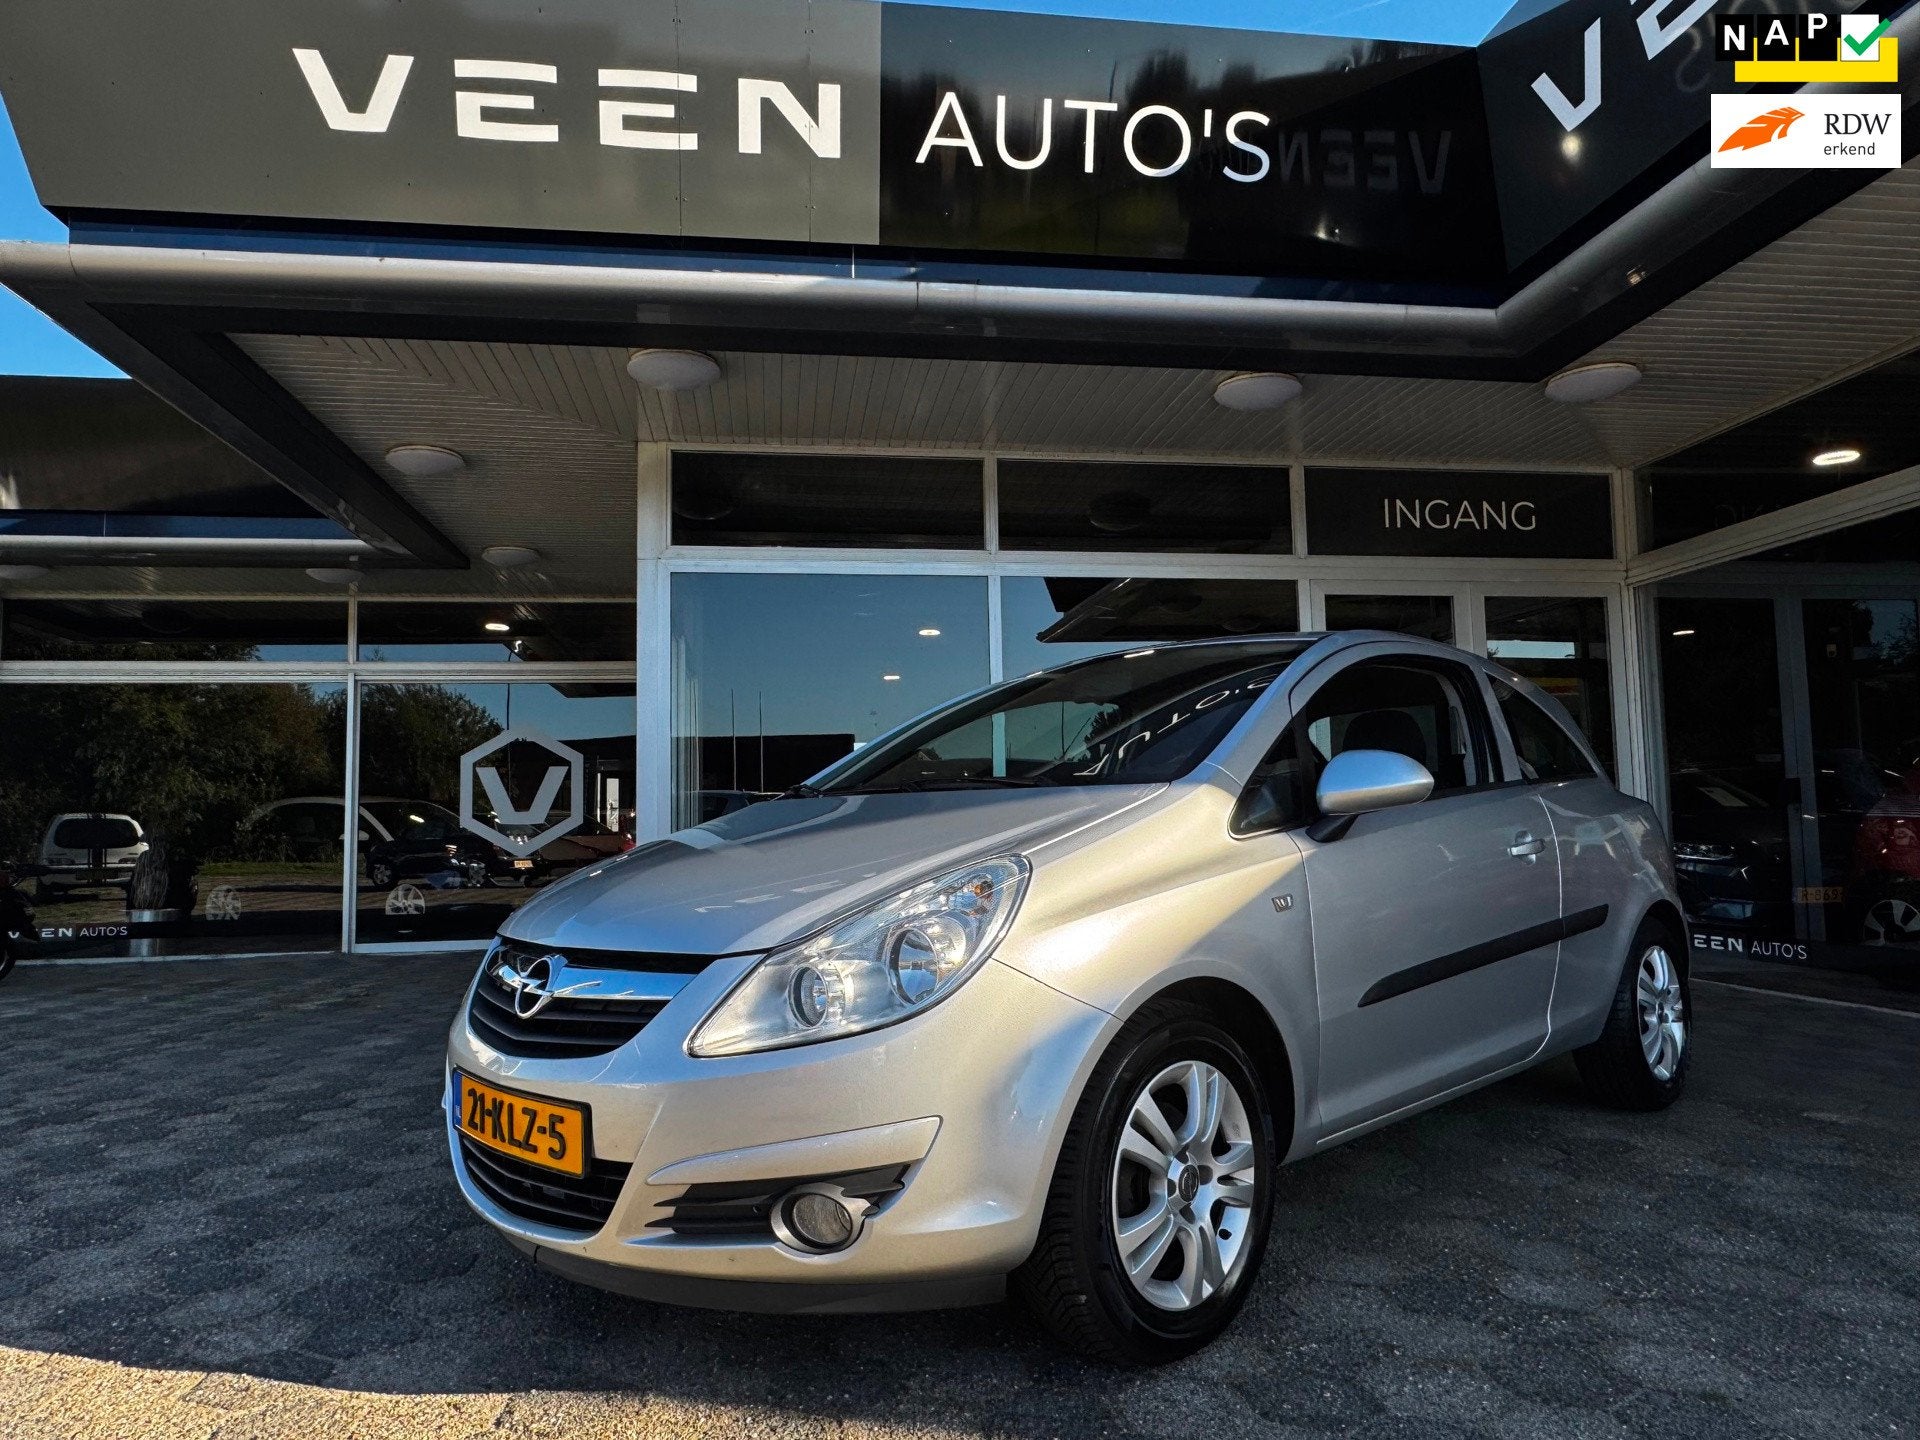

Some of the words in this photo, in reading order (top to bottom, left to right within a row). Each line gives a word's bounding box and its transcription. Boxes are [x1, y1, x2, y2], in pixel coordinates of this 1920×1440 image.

[293, 48, 841, 159] VEEN
[915, 91, 1271, 183] AUTO'S
[1384, 498, 1536, 531] INGANG
[8, 927, 73, 938] VEN
[80, 926, 128, 937] AUTO'S
[1693, 934, 1744, 952] EEN
[1751, 940, 1808, 960] AUTO'S
[467, 1087, 567, 1160] 21-KLZ-5
